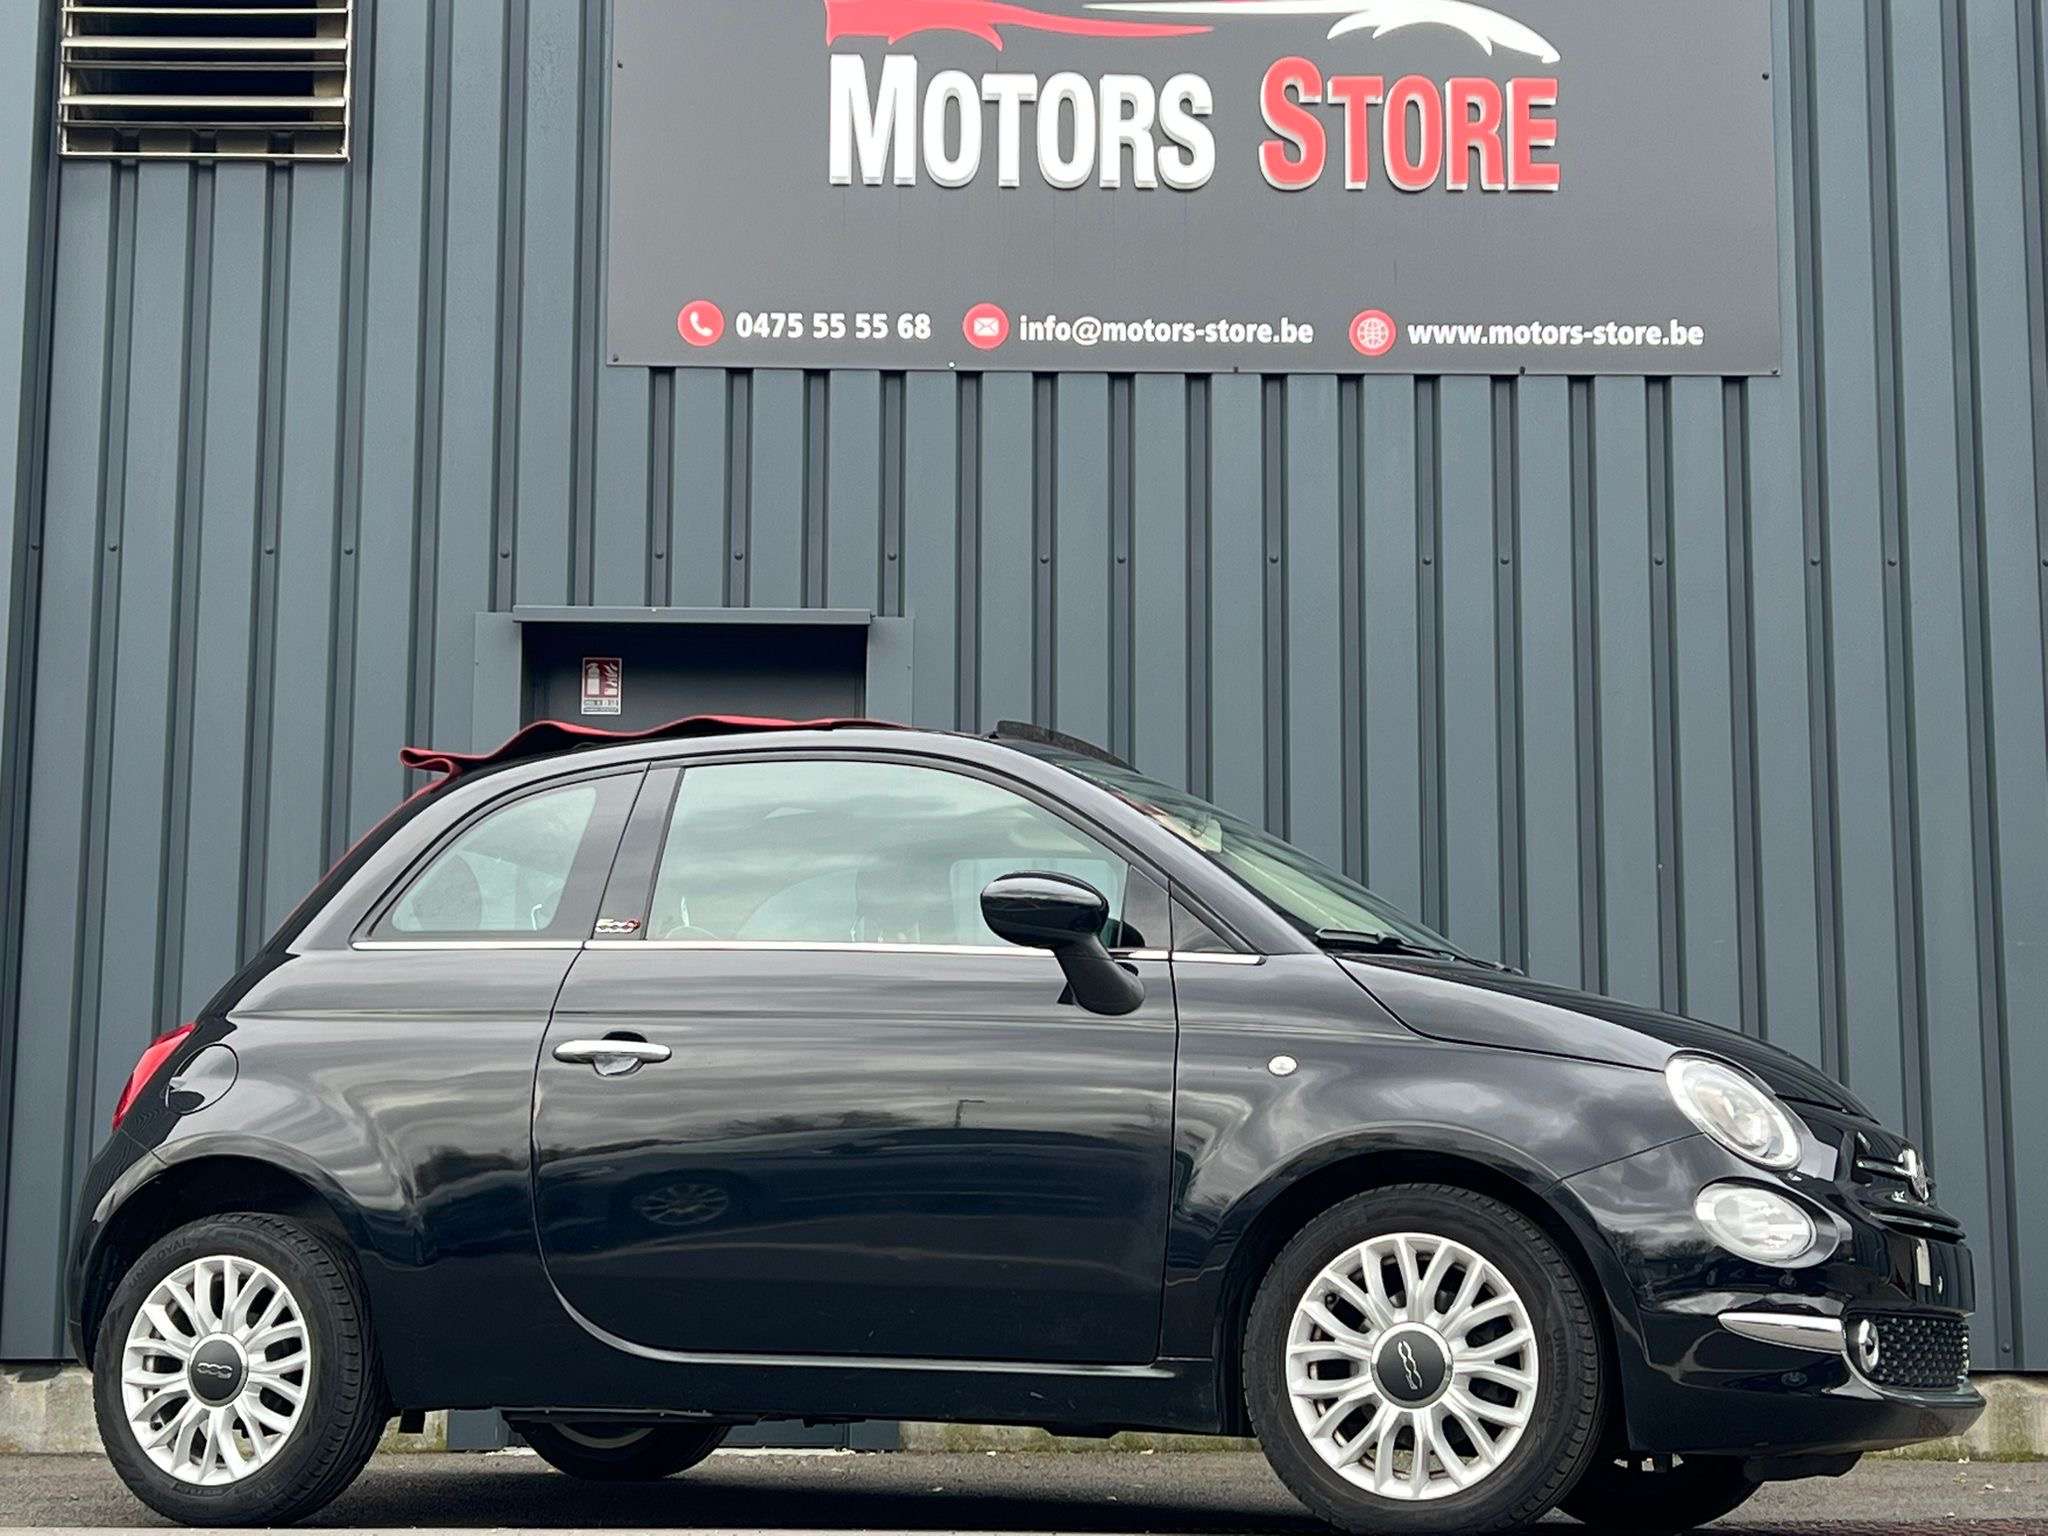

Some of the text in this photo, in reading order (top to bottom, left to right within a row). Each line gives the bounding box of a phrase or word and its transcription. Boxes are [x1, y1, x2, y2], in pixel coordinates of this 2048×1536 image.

[829, 54, 1561, 192] MOTORS STORE
[735, 312, 931, 340] 0475 55 55 68
[1019, 315, 1314, 347] info@motors-store.be
[1407, 319, 1705, 346] www.motors-store.be
